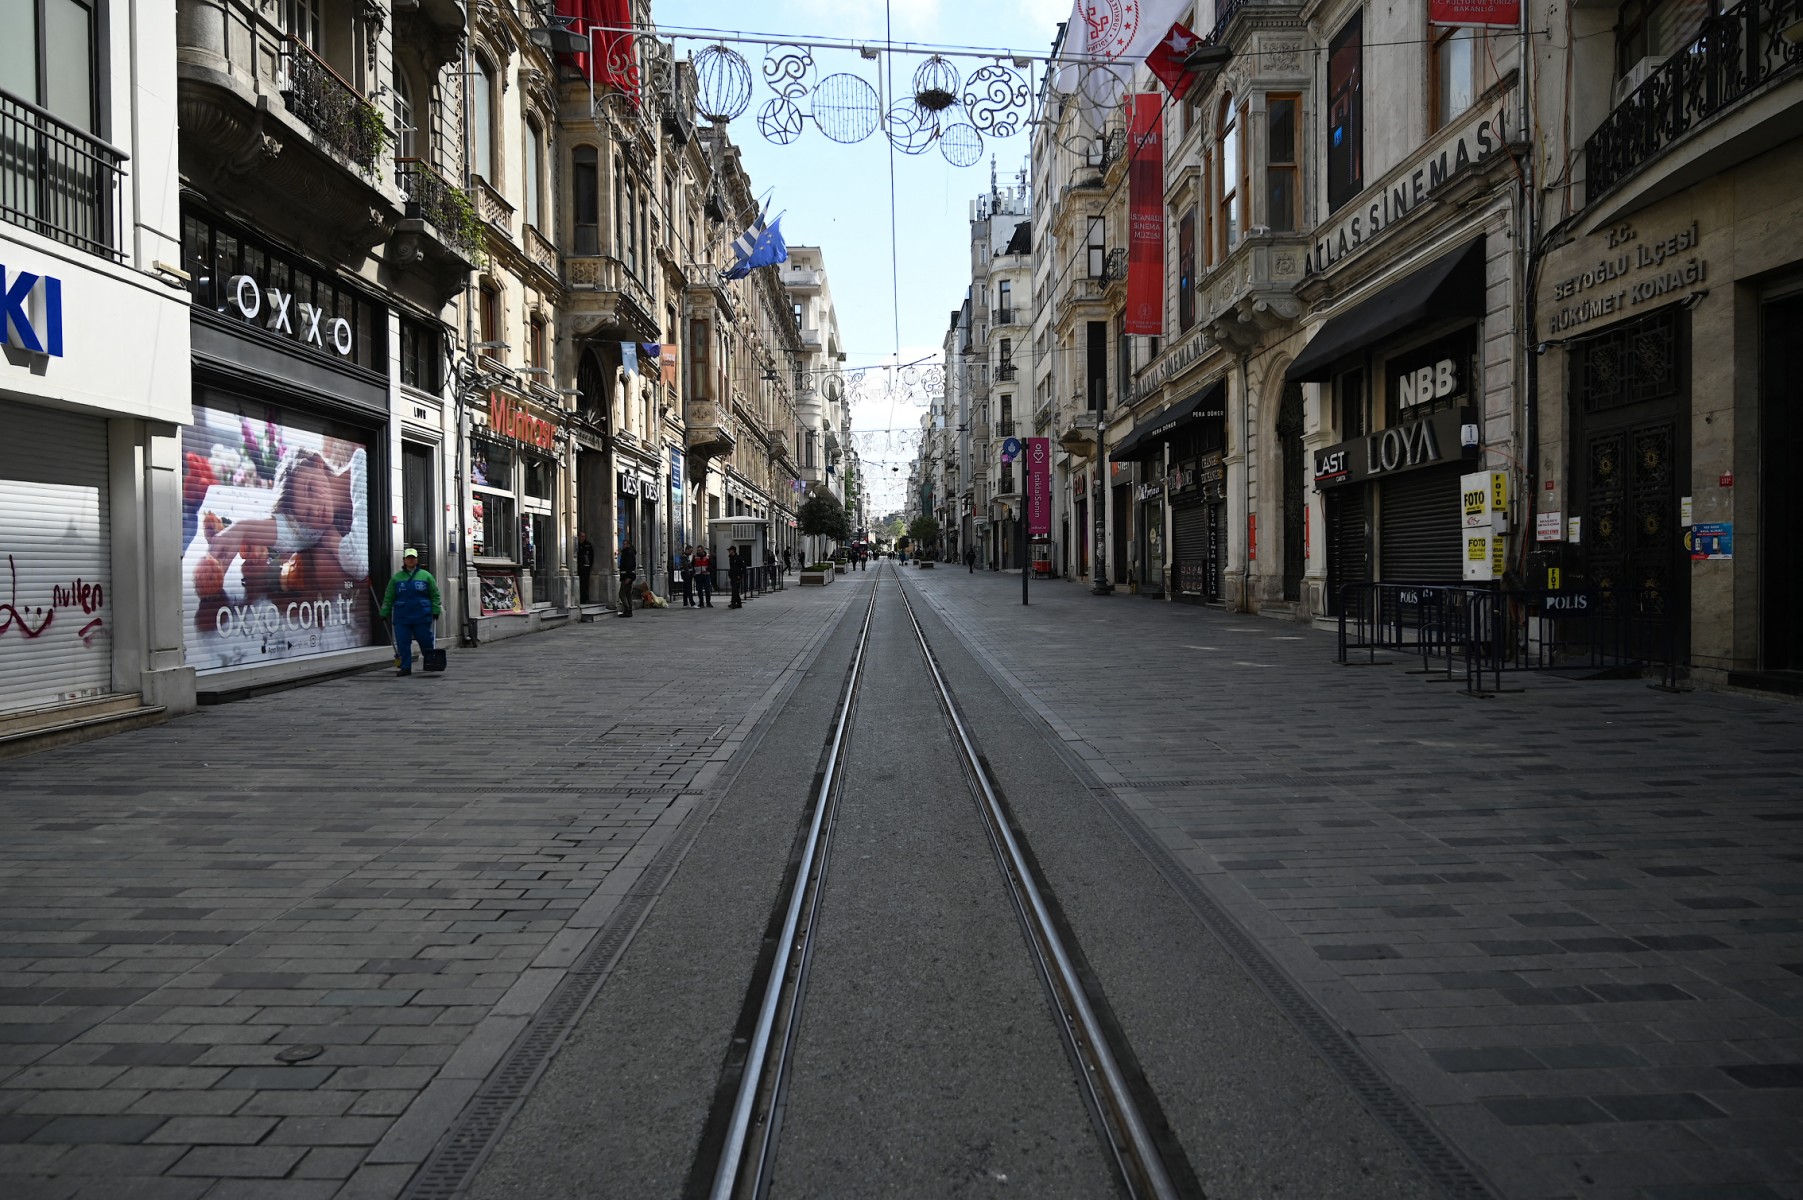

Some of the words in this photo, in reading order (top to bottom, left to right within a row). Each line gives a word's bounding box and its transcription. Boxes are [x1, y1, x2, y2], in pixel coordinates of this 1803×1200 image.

[1305, 217, 1361, 276] ATLAS
[1369, 107, 1506, 234] SİNEMASI
[1605, 222, 1637, 250] T.C.
[1554, 255, 1629, 301] BEYOĞLU
[1636, 220, 1699, 269] İLÇESİ
[1549, 289, 1626, 334] HÜKÜMET
[1631, 257, 1707, 305] KONAĞI
[228, 274, 352, 356] OXXO
[1399, 358, 1455, 410] NBB
[1206, 409, 1225, 417] DÖNER
[1366, 421, 1440, 475] LOYA
[1314, 450, 1345, 477] LAST
[622, 474, 639, 496] DES
[1464, 490, 1485, 507] FOTO
[1468, 539, 1486, 547] FOTO
[1400, 590, 1418, 604] POLİS
[1546, 593, 1588, 610] POLİS
[216, 593, 354, 639] oxxo.com.tr
